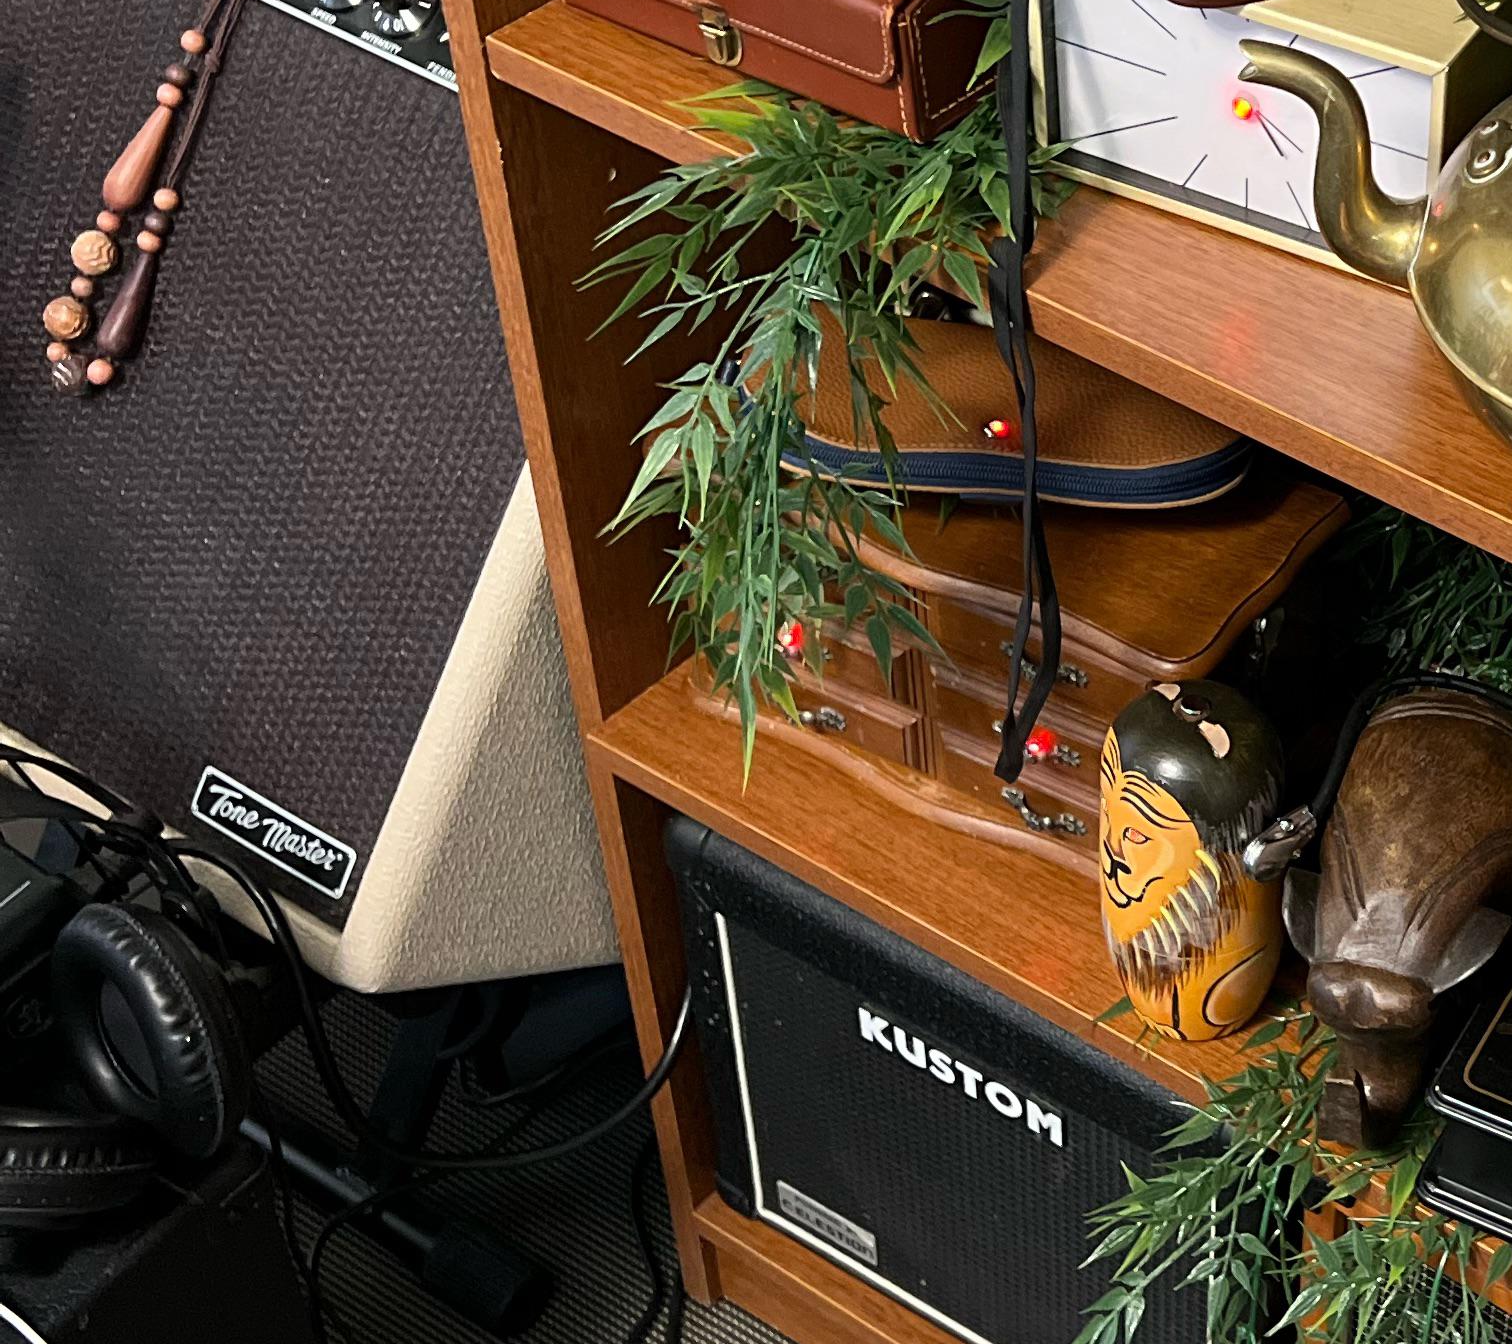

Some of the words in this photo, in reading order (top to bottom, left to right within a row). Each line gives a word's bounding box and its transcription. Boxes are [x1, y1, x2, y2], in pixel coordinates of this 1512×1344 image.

[310, 7, 337, 25] SPEED
[361, 30, 402, 56] INTENSITY
[209, 783, 260, 830] Tone
[262, 818, 336, 870] Master
[858, 1006, 1063, 1148] KUSTOM
